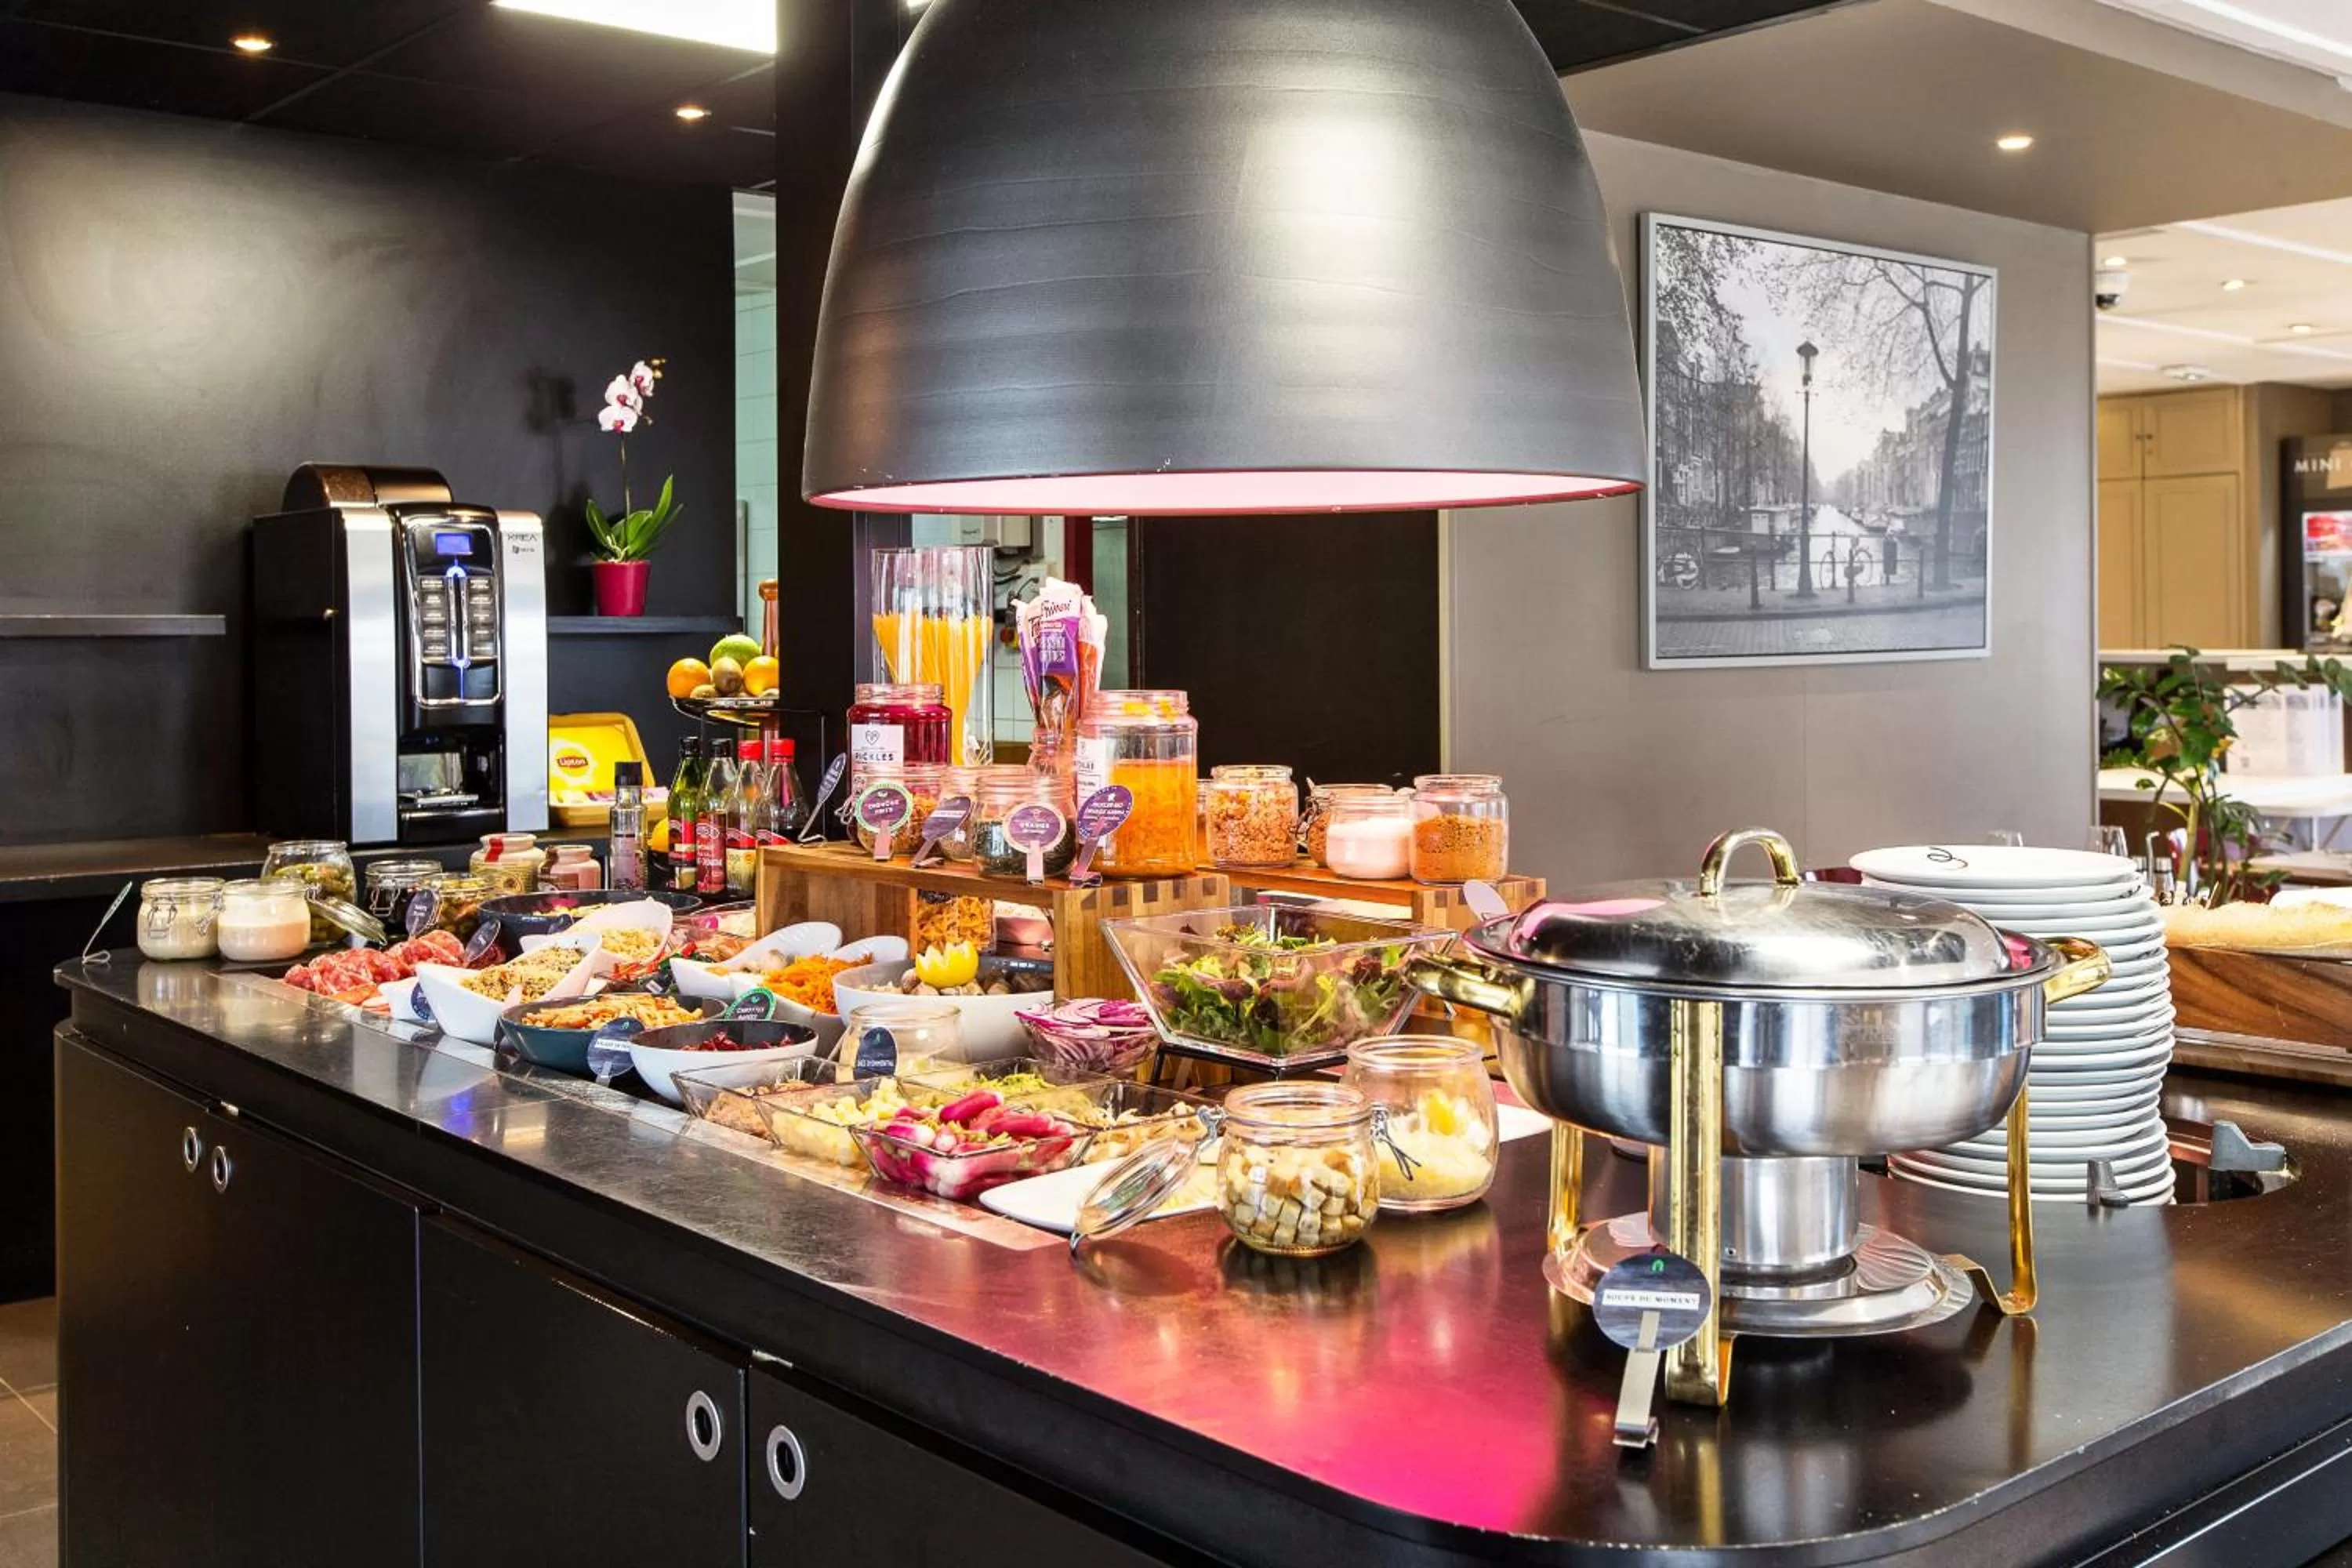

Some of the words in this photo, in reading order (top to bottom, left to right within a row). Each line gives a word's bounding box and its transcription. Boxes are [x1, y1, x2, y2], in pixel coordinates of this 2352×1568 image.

[2294, 458, 2341, 473] MINI
[855, 752, 895, 762] PICKLES
[559, 757, 586, 768] Lipton
[1655, 1295, 1697, 1304] MOMENT
